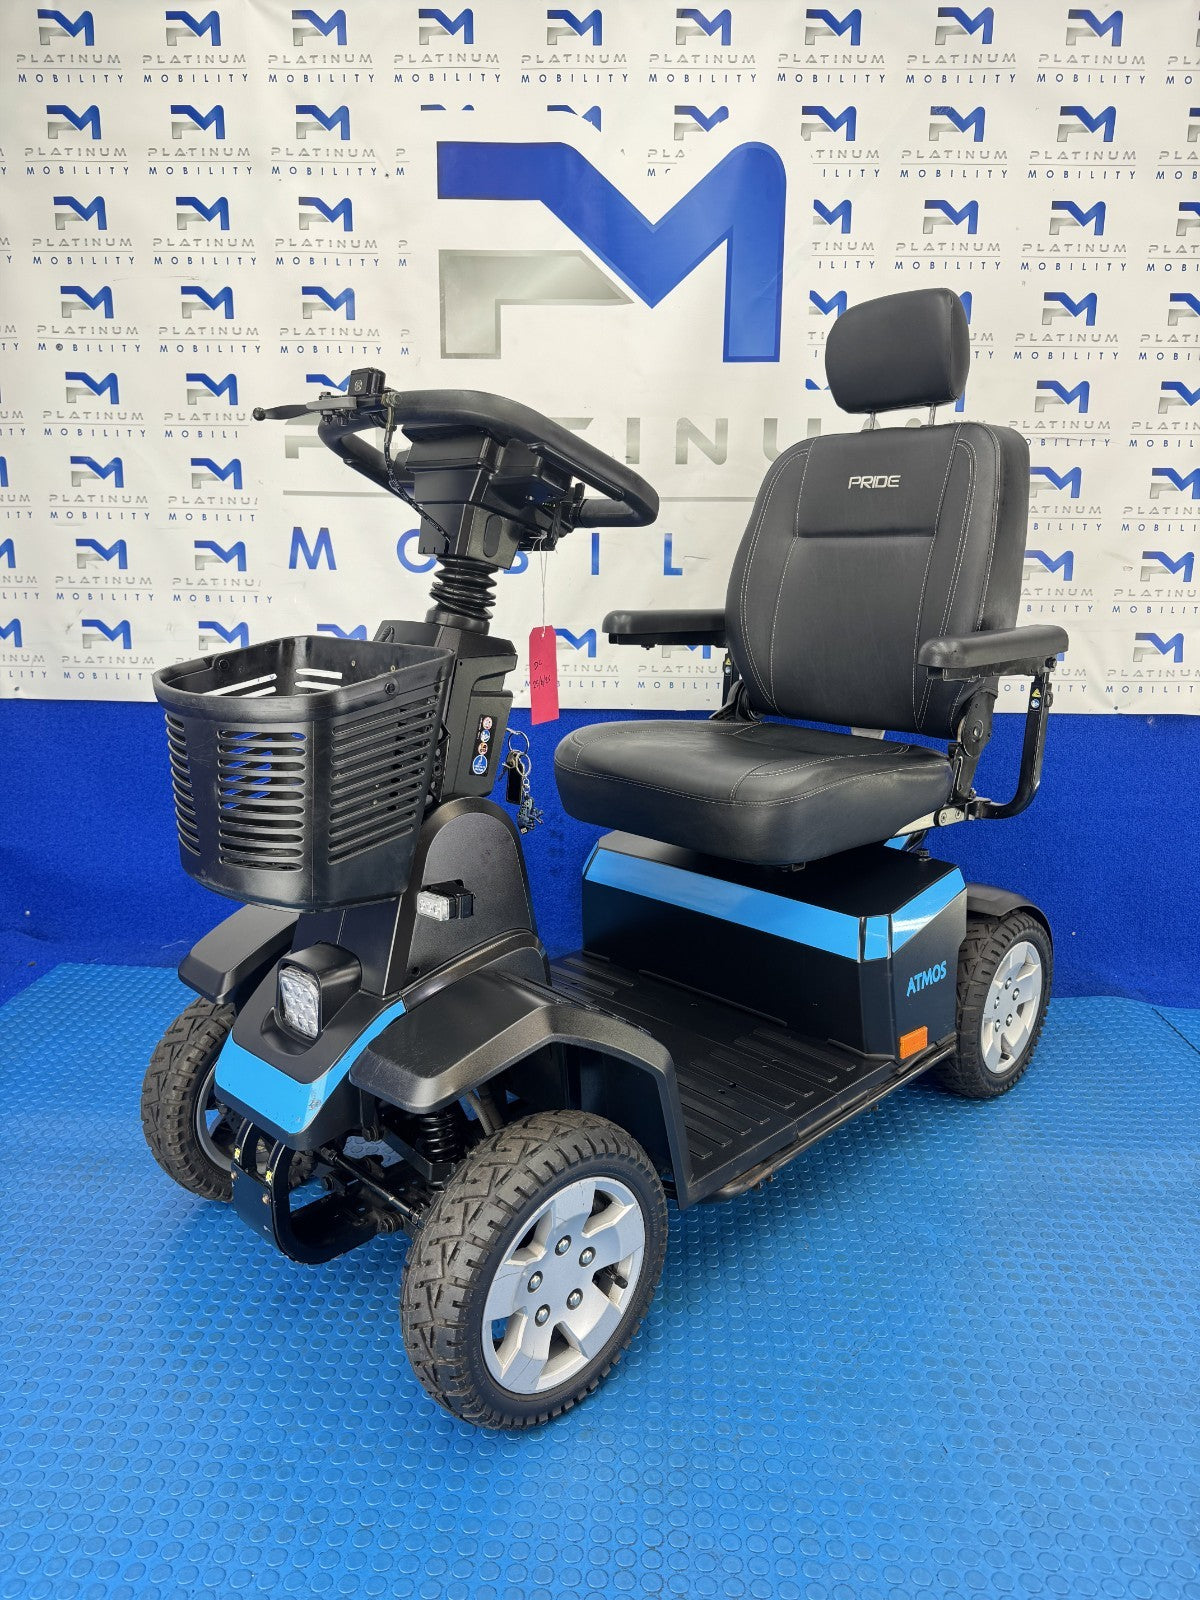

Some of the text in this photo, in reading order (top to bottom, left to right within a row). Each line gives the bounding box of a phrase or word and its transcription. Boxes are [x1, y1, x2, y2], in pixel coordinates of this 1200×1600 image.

[17, 54, 120, 63] PLATINUM
[142, 54, 246, 63] PLATINUM
[268, 54, 372, 64] PLATINUM
[394, 53, 499, 63] PLATINUM
[521, 54, 627, 63] PLATINUM
[649, 54, 755, 63] PLATINUM
[779, 54, 884, 63] PLATINUM
[907, 53, 1016, 63] PLATINUM
[1039, 54, 1145, 64] PLATINUM
[18, 74, 123, 83] MOBILITY
[144, 74, 247, 82] MOBILITY
[269, 74, 374, 82] MOBILITY
[394, 73, 500, 82] MOBILITY
[521, 74, 628, 83] MOBILITY
[649, 74, 756, 82] MOBILITY
[778, 73, 885, 83] MOBILITY
[906, 74, 1015, 83] MOBILITY
[1037, 74, 1145, 84] MOBILITY
[25, 147, 126, 156] PLATINUM
[148, 148, 250, 156] PLATINUM
[271, 147, 375, 157] PLATINUM
[811, 150, 879, 158] TINUM
[902, 150, 1007, 159] PLATINUM
[1030, 151, 1136, 160] PLATINUM
[27, 166, 128, 175] MOBILITY
[149, 167, 252, 175] MOBILITY
[272, 166, 376, 175] MOBILITY
[824, 169, 879, 177] ILITY
[900, 170, 1007, 178] MOBILITY
[1028, 170, 1135, 179] MOBILITY
[32, 238, 132, 247] PLATINUM
[153, 238, 254, 247] PLATINUM
[275, 238, 377, 248] PLATINUM
[812, 242, 874, 250] TINUM
[896, 243, 1000, 251] PLATINUM
[1022, 244, 1126, 252] PLATINUM
[1149, 245, 1200, 253] PLAT
[33, 256, 134, 264] MOBILITY
[154, 257, 256, 265] MOBILITY
[276, 257, 379, 266] MOBILITY
[819, 261, 874, 269] ILITY
[895, 262, 1000, 270] MOBILITY
[1021, 262, 1126, 271] MOBILITY
[37, 325, 138, 334] PLATINUM
[159, 327, 259, 335] PLATINUM
[280, 328, 379, 336] PLATINUM
[1015, 333, 1118, 342] PLATINUM
[1141, 334, 1198, 342] PLATI
[38, 343, 140, 352] MOBILITY
[160, 345, 260, 353] MOBILITY
[281, 345, 381, 354] MOBILITY
[1139, 352, 1190, 360] MOBI
[43, 411, 143, 420] PLATINUM
[164, 413, 245, 421] PLATINU
[1008, 420, 1111, 430] PLATINUM
[1132, 422, 1200, 430] PLATIN
[44, 428, 145, 437] MOBILITY
[165, 430, 237, 438] MOBILI
[1025, 439, 1111, 447] OBILITY
[848, 475, 901, 489] PRIDE
[49, 494, 148, 503] PLATINUM
[1029, 505, 1101, 514] ATINUM
[1123, 506, 1200, 514] PLATIN
[50, 511, 150, 520] MOBILITY
[169, 513, 254, 521] MOBILIT
[1034, 523, 1101, 531] BILITY
[55, 576, 152, 584] PLATINUM
[1021, 588, 1093, 596] ATINUM
[1114, 589, 1196, 597] PLATINU
[56, 593, 153, 601] MOBILITY
[173, 594, 272, 603] MOBILITY
[1112, 606, 1198, 614] MOBILIT
[62, 656, 155, 664] PLATINUM
[637, 665, 719, 674] PLATINU
[64, 672, 142, 680] MOBILIT
[637, 682, 720, 690] MOBILIT
[1004, 684, 1087, 692] OBITY
[906, 960, 947, 997] ATMOS
